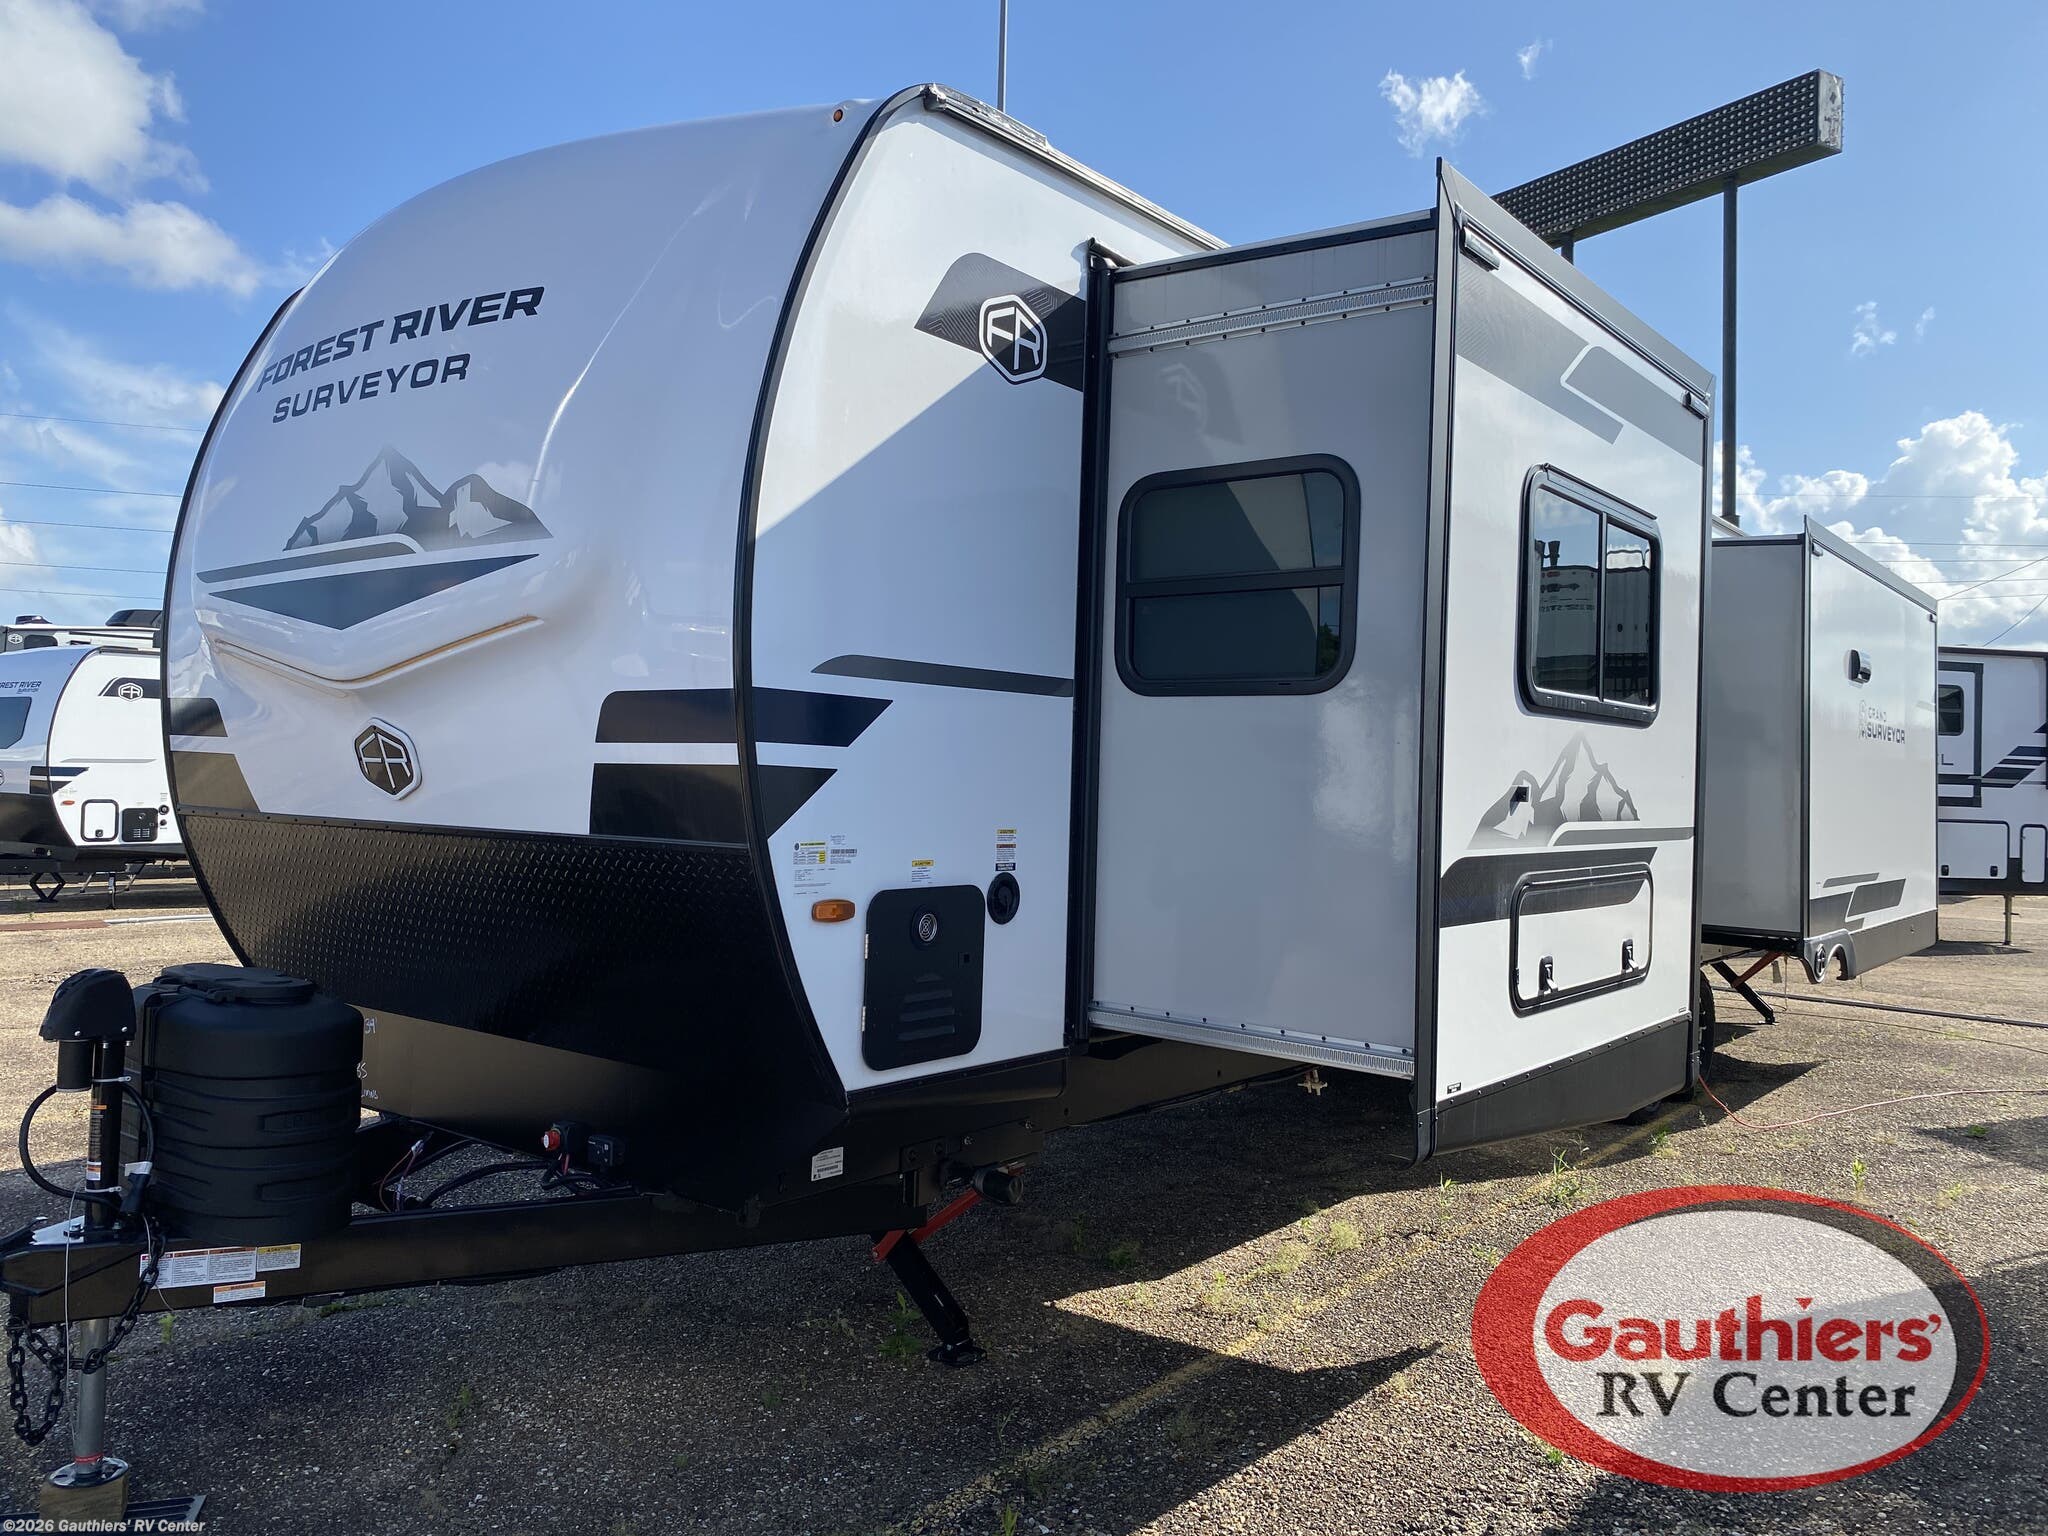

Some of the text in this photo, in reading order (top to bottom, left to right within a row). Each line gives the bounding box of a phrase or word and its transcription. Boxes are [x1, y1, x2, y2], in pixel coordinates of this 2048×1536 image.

[256, 286, 545, 393] FOREST RIVER
[272, 353, 471, 424] SURVEYOR
[1867, 722, 1905, 744] SURVEYOR
